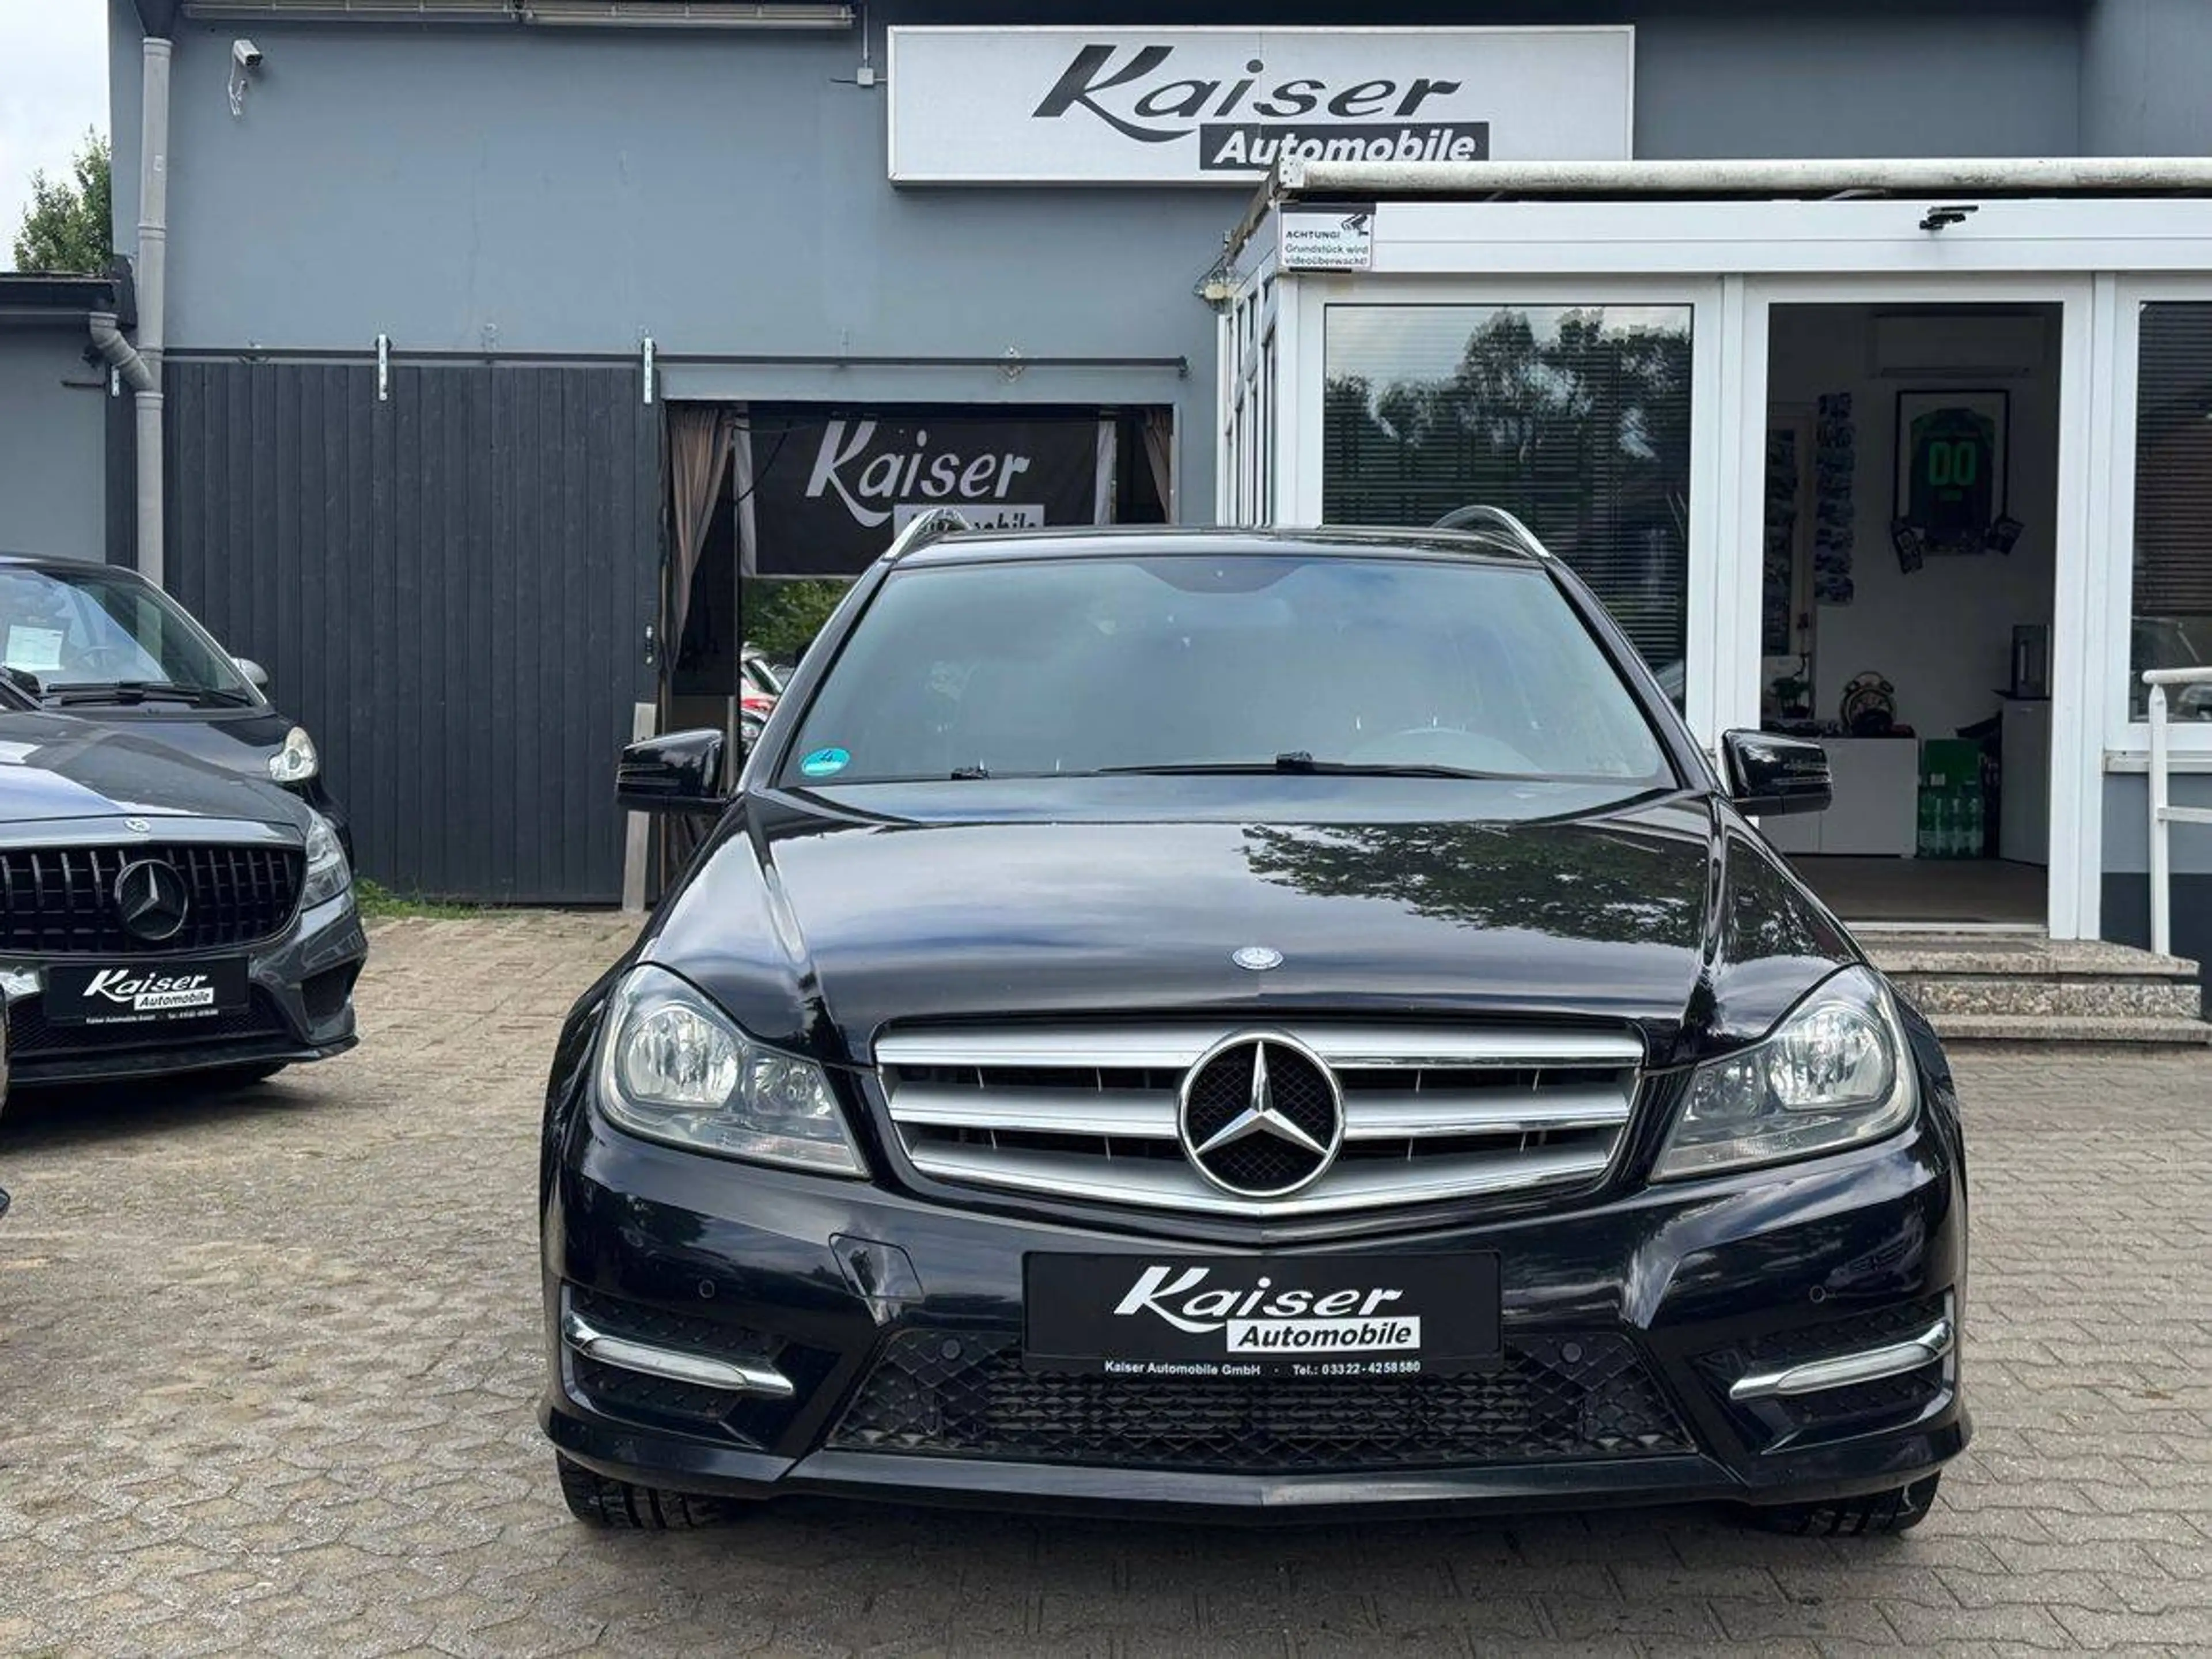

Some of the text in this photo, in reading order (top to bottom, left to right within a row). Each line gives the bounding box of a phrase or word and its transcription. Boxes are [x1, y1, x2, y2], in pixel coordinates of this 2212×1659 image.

[1033, 44, 1461, 143] Kaiser
[1213, 129, 1476, 164] Automobile
[1285, 230, 1340, 239] ACHTUNG!
[806, 420, 1031, 528] Kaiser
[83, 969, 207, 1002] Kaiser
[139, 991, 210, 1007] Automobile
[1113, 1266, 1403, 1334] Kaiser
[1238, 1322, 1412, 1347] Automobile
[1104, 1359, 1145, 1373] Kaiser
[1146, 1362, 1218, 1375] Automobile
[1221, 1363, 1261, 1376] GmbH
[1291, 1363, 1318, 1376] Tel.:
